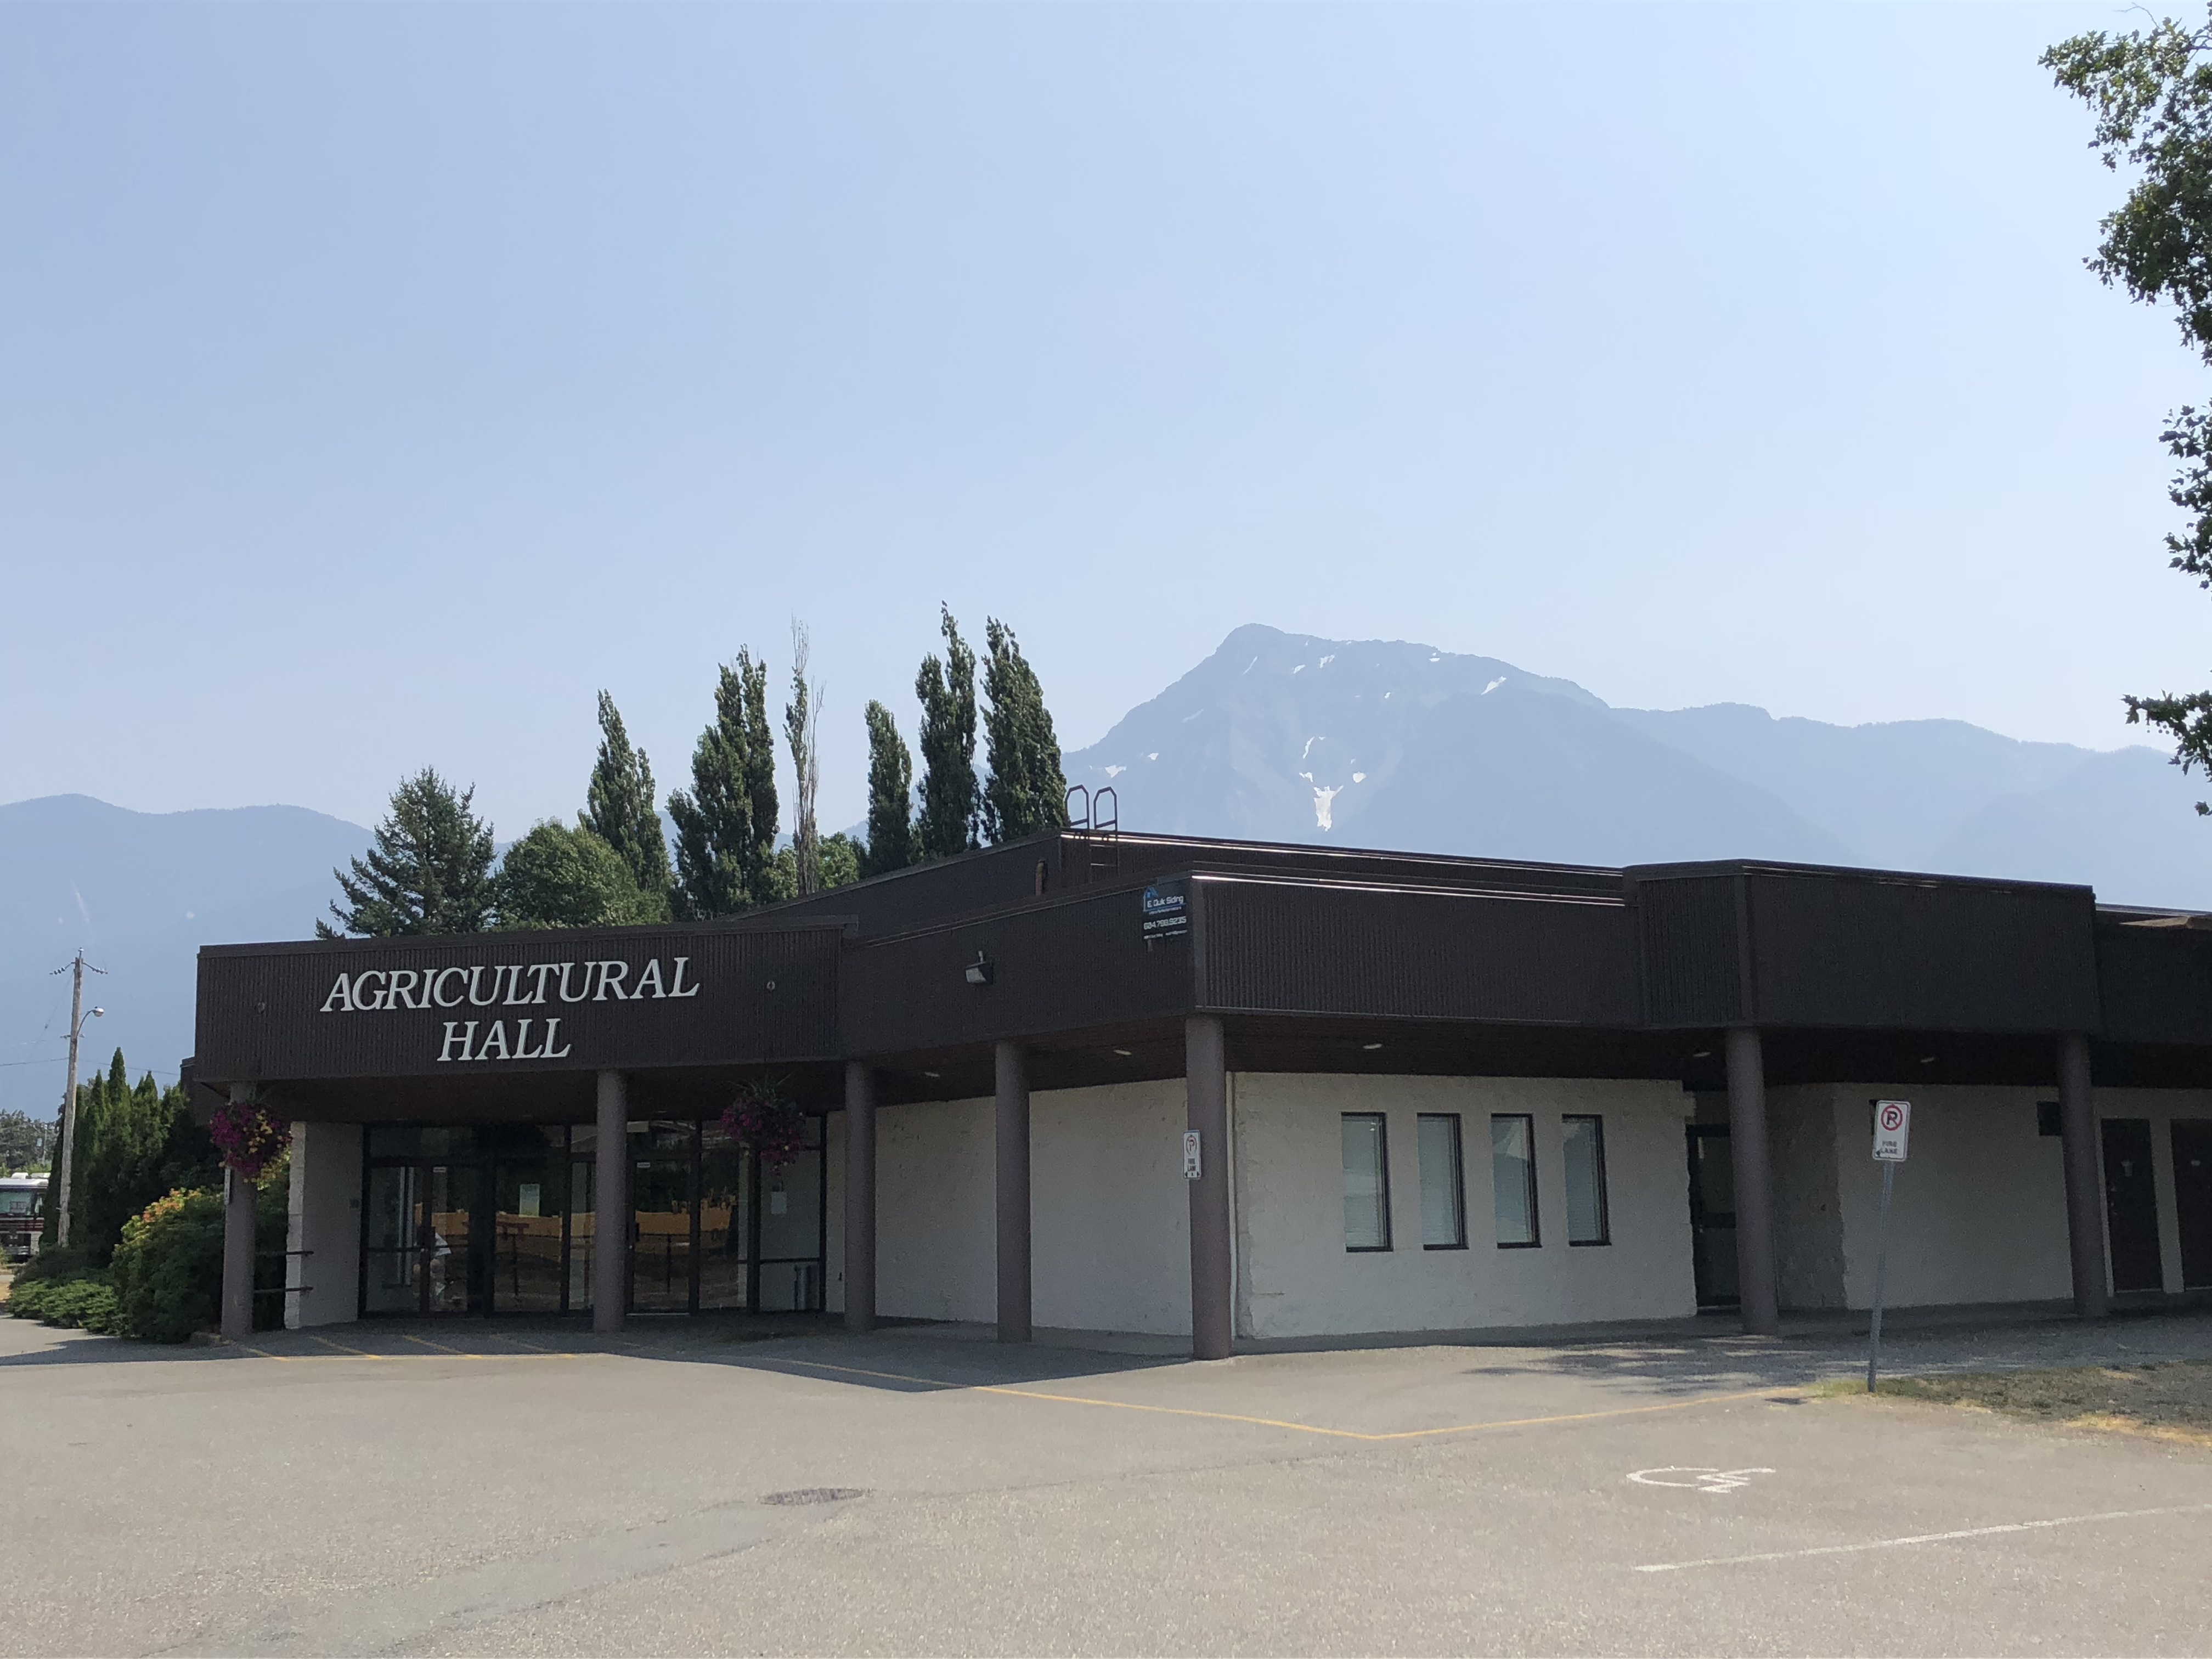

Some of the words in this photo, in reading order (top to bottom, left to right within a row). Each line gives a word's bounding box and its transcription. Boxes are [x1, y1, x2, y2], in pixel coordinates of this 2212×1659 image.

[1166, 895, 1184, 904] Siding
[320, 957, 699, 1012] AGRICULTURAL
[437, 1018, 572, 1062] HALL
